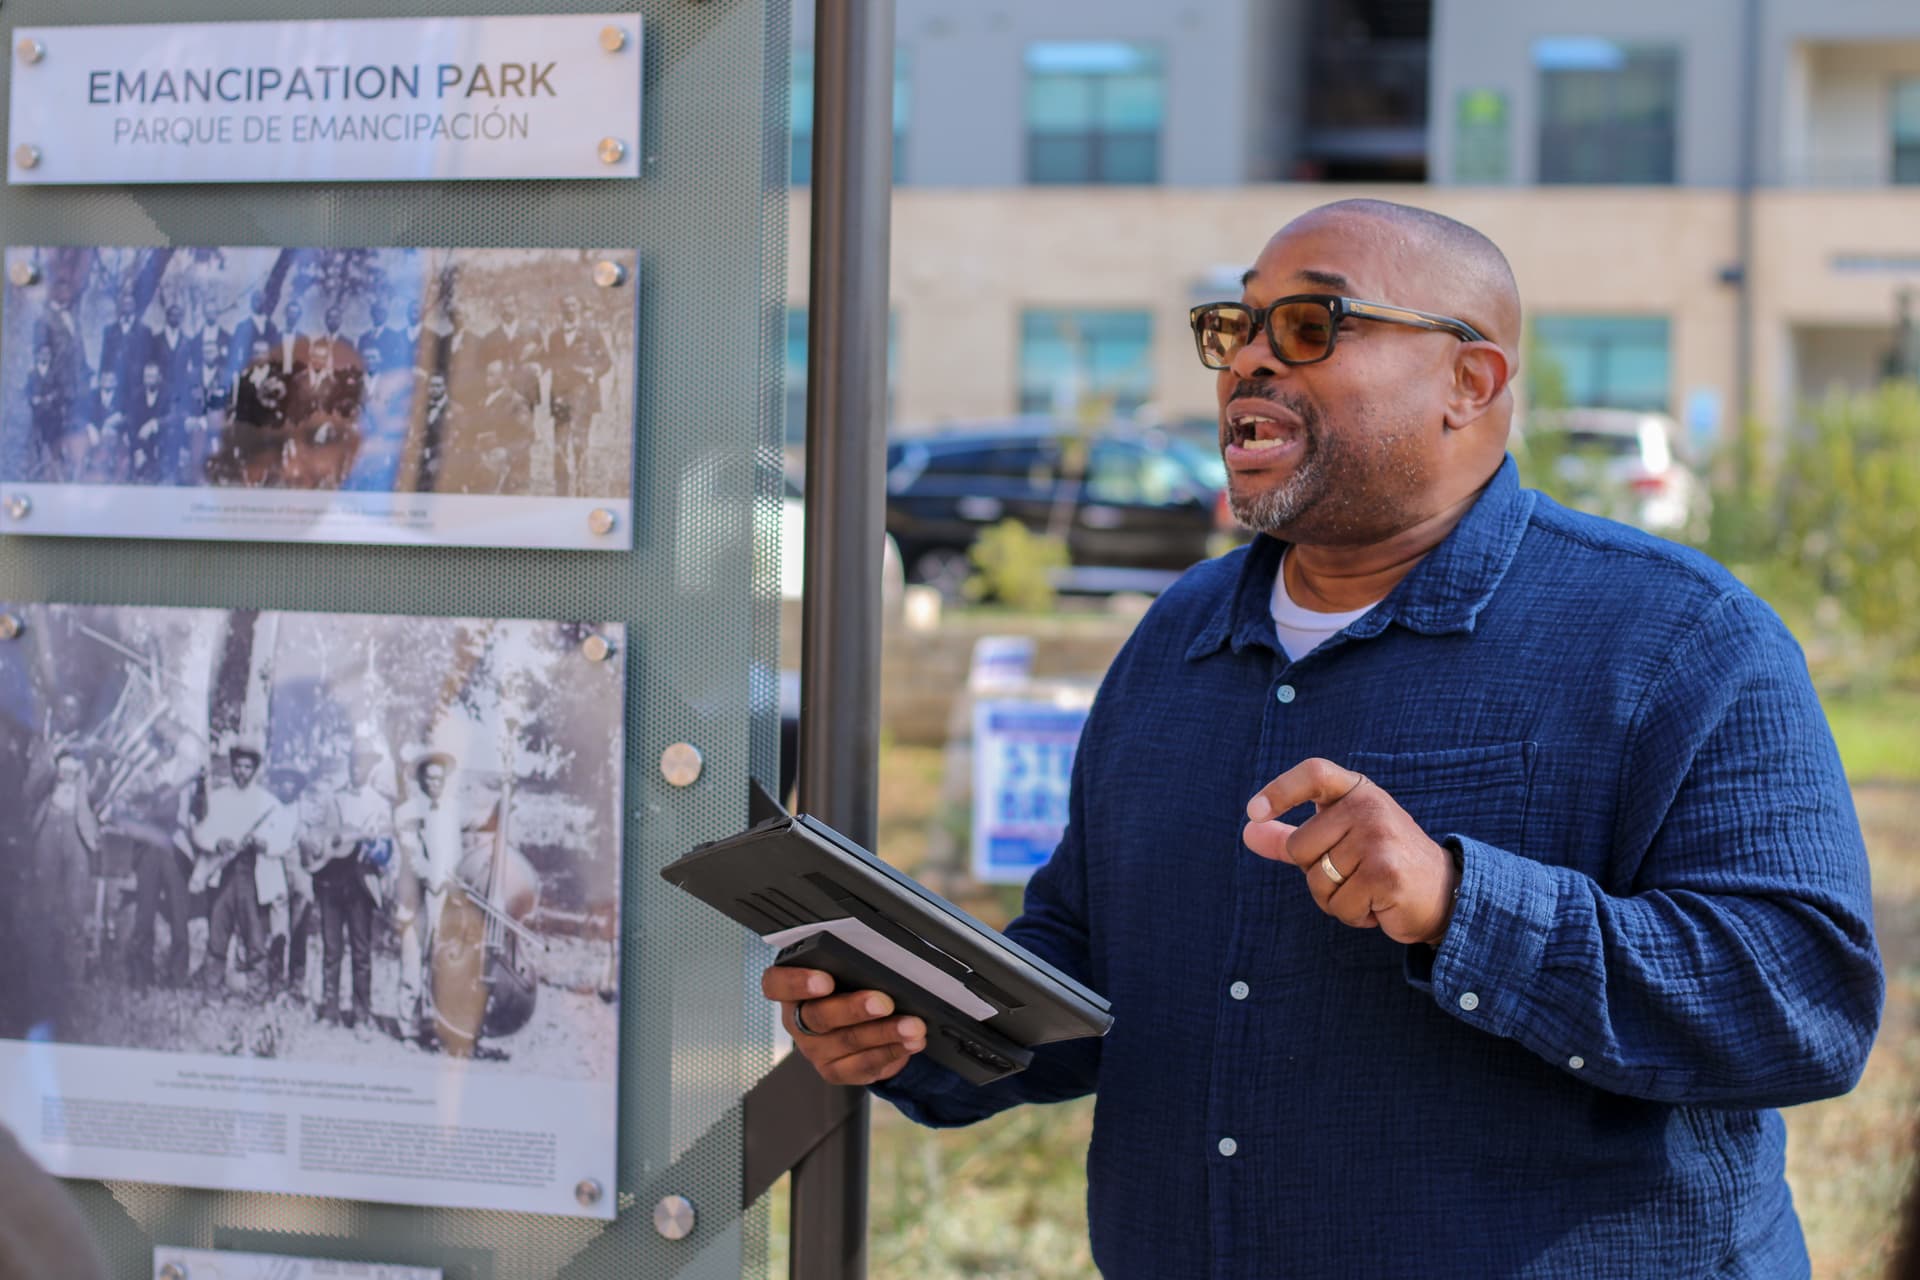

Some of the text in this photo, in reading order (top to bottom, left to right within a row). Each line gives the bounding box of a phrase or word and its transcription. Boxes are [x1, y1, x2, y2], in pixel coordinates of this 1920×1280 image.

[87, 61, 558, 105] EMANCIPATION PARK
[113, 105, 530, 147] PARQUE DE EMANCIPACIÓN
